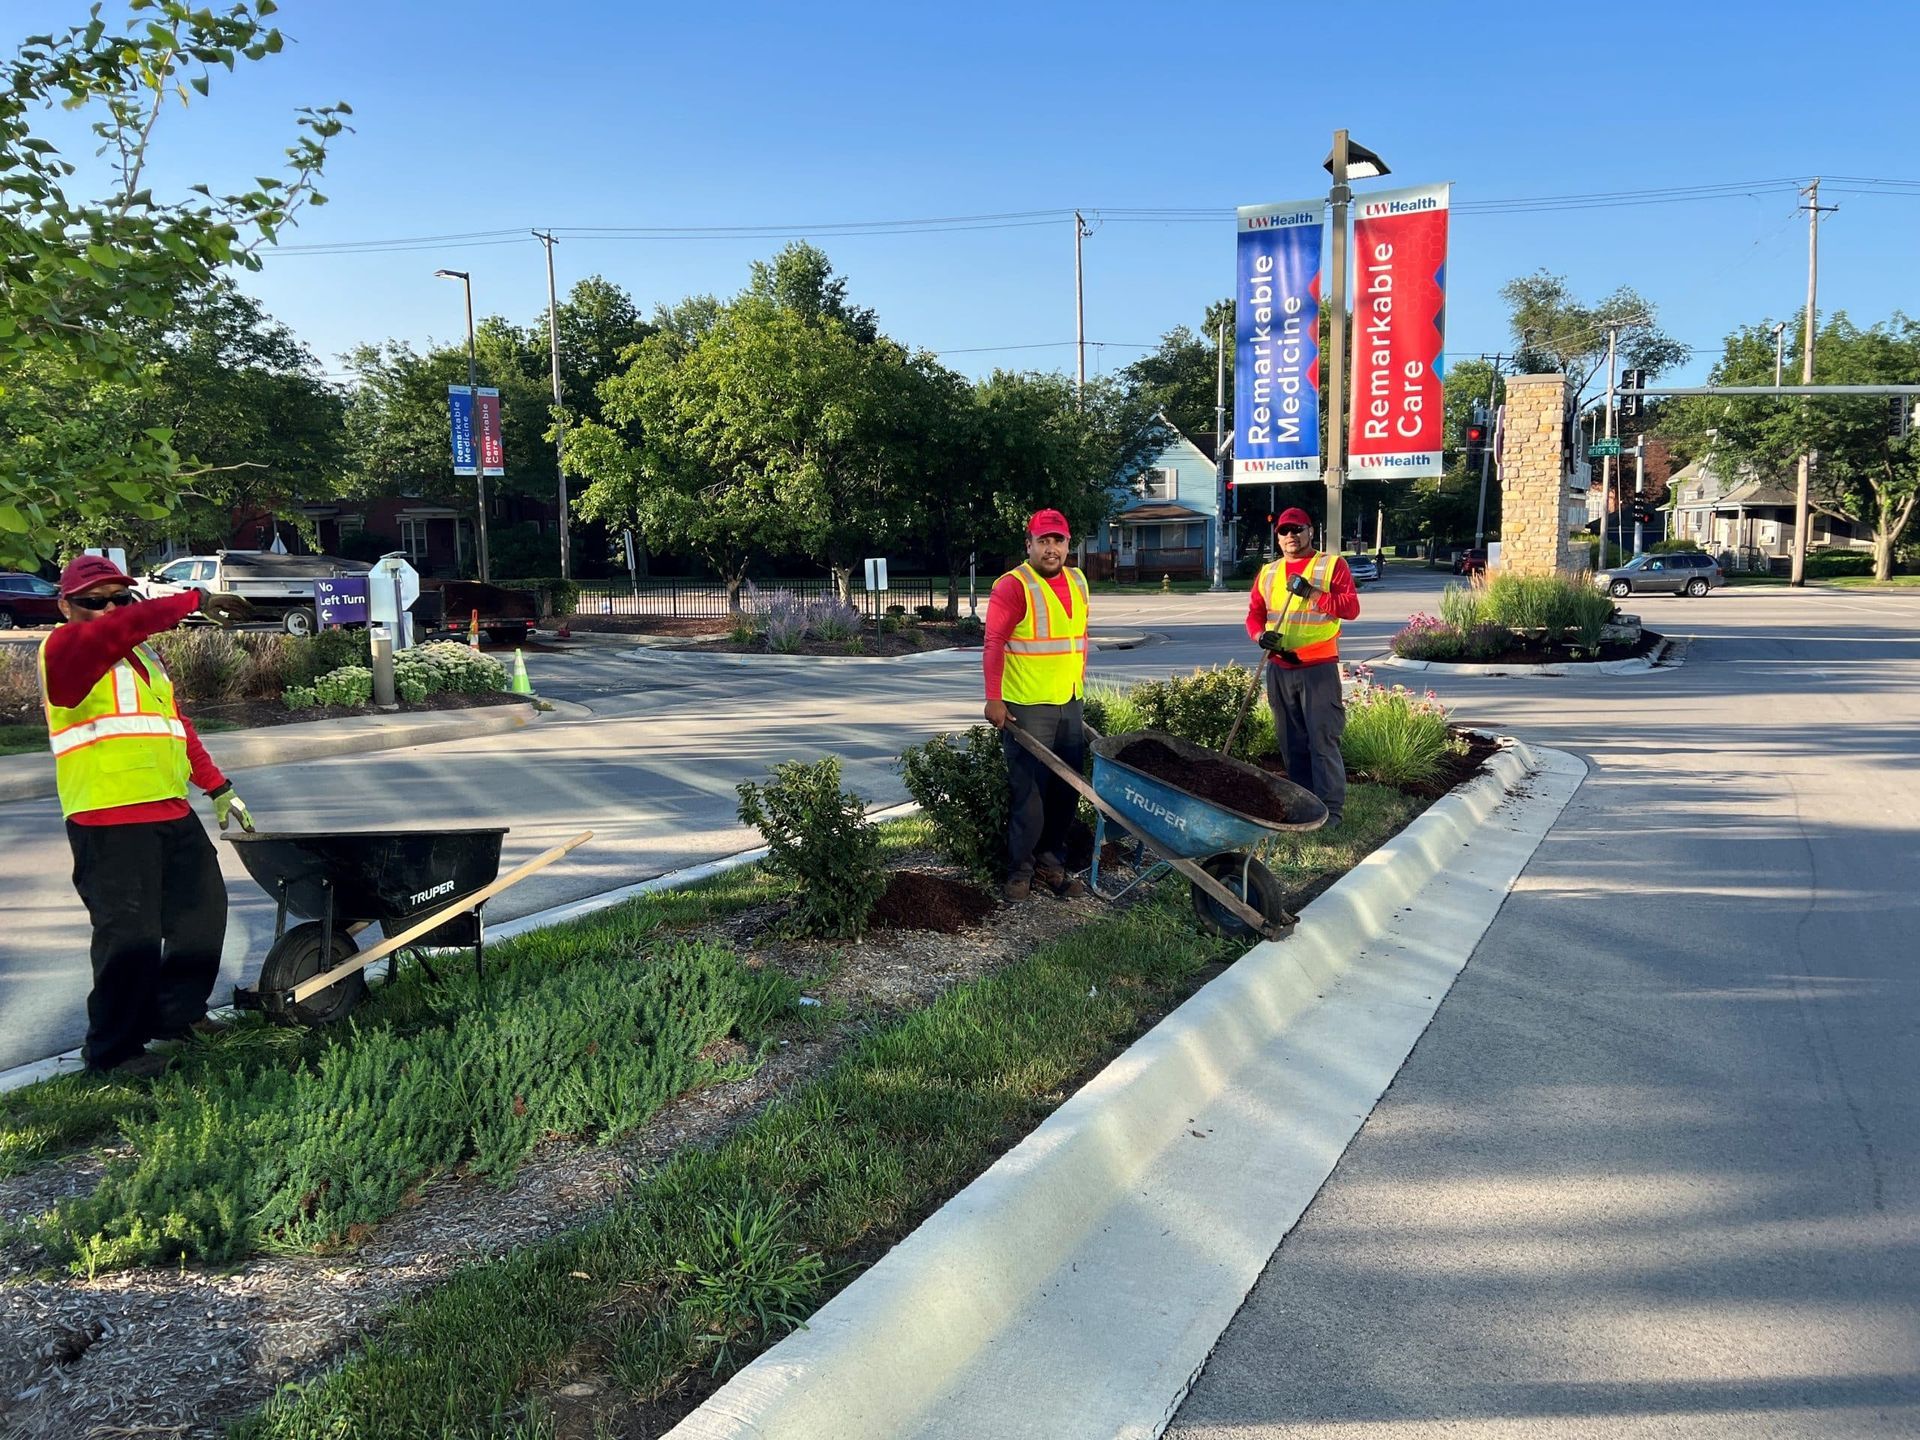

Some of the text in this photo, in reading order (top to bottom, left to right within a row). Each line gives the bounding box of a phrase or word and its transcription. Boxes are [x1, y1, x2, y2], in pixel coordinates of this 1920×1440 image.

[1248, 254, 1274, 444] Remarkable
[1277, 296, 1301, 443] Medicine
[1364, 242, 1393, 439] Remarkable
[1397, 360, 1424, 438] Care
[454, 402, 463, 462] Remarkable
[463, 416, 471, 462] Medicine
[483, 404, 491, 463] Remarkable
[320, 594, 365, 605] Left Turn
[1123, 786, 1187, 832] TRUPER
[409, 880, 455, 906] TRUPER
